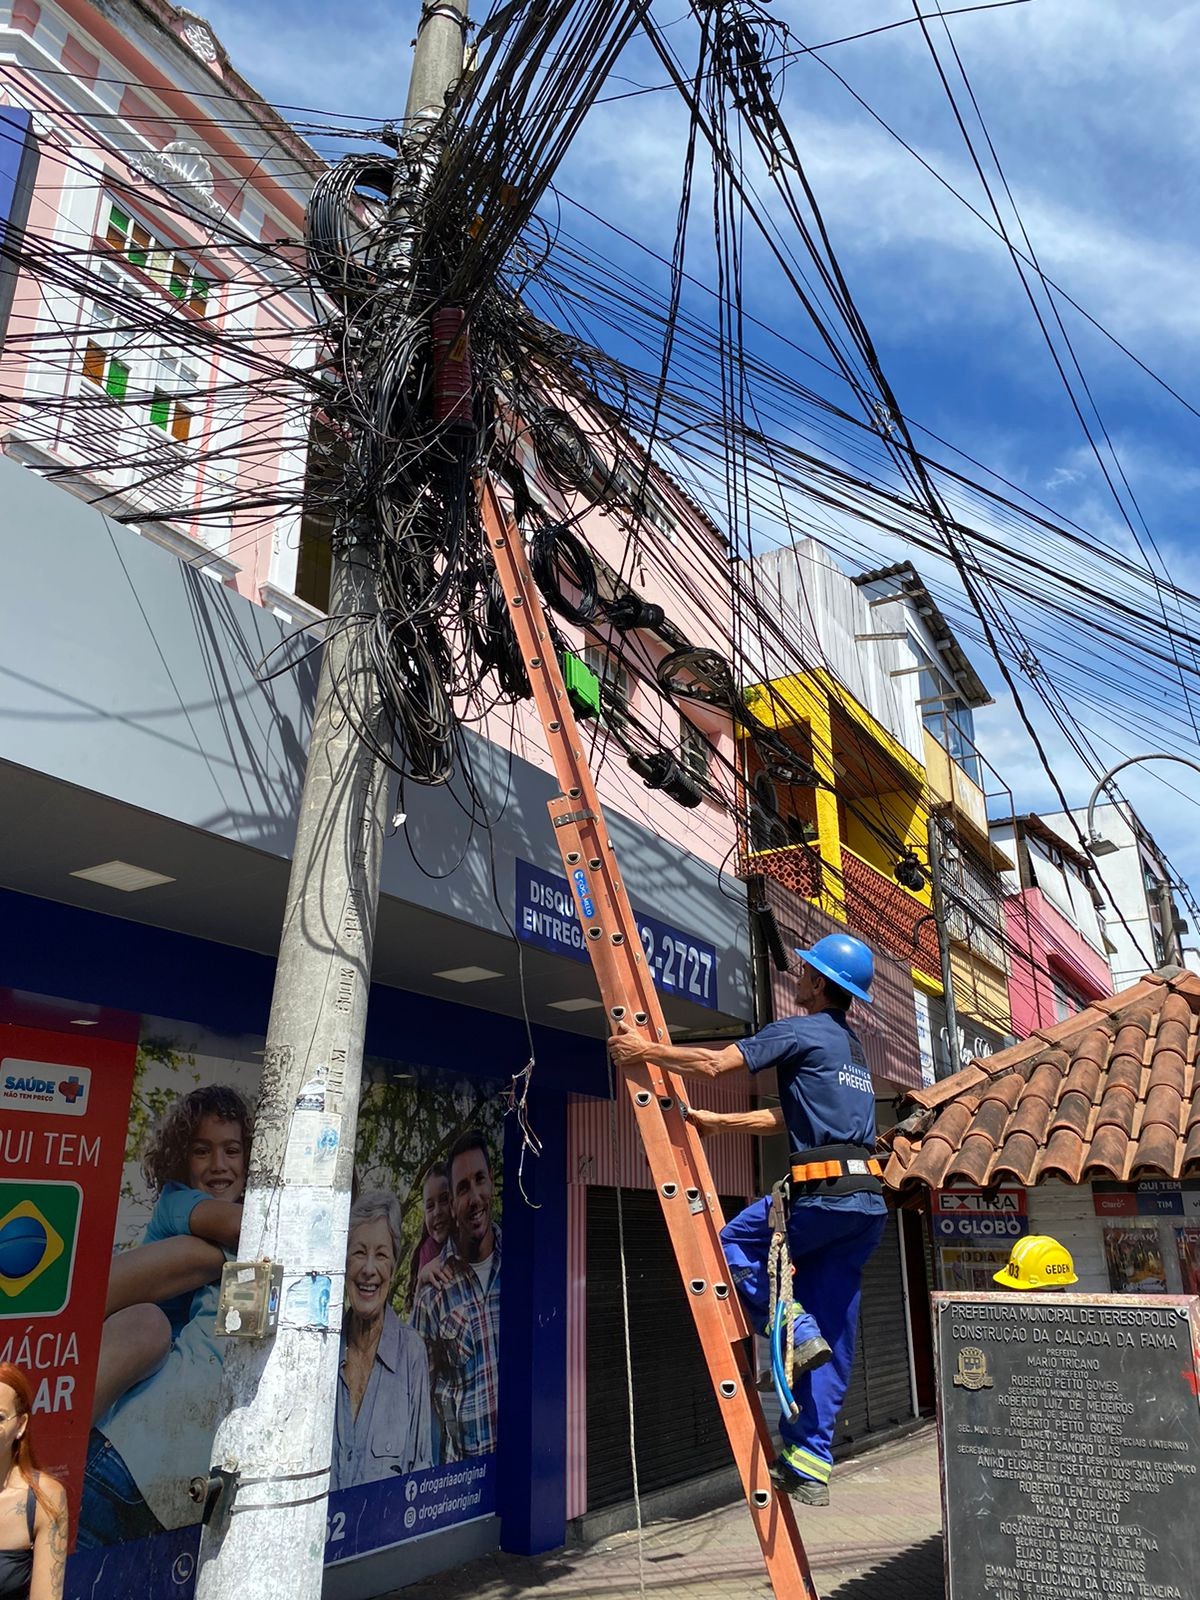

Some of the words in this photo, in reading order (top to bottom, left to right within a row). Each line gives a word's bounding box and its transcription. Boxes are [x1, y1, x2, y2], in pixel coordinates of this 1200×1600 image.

[636, 922, 712, 998] 2-2727
[4, 1076, 55, 1094] SAÚDE
[838, 1071, 875, 1095] PREFEIT
[0, 1129, 33, 1163] UI
[44, 1132, 101, 1167] TEM
[1138, 1182, 1158, 1191] QUI
[1161, 1182, 1181, 1190] TEM
[941, 1195, 1016, 1210] EXTRA
[1101, 1200, 1121, 1208] Claro
[941, 1219, 954, 1234] O
[958, 1221, 1021, 1235] GLOBO
[951, 1305, 1018, 1320] PREFEITURA
[1019, 1307, 1078, 1323] MUNICIPAL
[1080, 1309, 1096, 1324] DE
[1098, 1309, 1178, 1328] TERESÓPOLIS
[952, 1324, 1027, 1342] CONSTRUÇÃO
[1033, 1328, 1050, 1343] DA
[1055, 1329, 1111, 1347] CALÇADA
[1116, 1332, 1135, 1348] DA
[1140, 1333, 1177, 1350] FAMA
[1046, 1348, 1077, 1357] PREFEITO
[1027, 1356, 1057, 1368] MARIO
[1060, 1358, 1099, 1370] TRICANO
[1038, 1368, 1089, 1379] VICE-PREFEITO
[1011, 1375, 1051, 1388] ROBERTO
[1054, 1377, 1083, 1390] PETTO
[1086, 1379, 1119, 1392] GOMES
[998, 1395, 1038, 1408] ROBERTO
[1043, 1398, 1063, 1409] LUIZ
[1069, 1399, 1081, 1411] DE
[1087, 1400, 1134, 1414] MEDEIROS
[1050, 1389, 1085, 1400] MUNICIPAL
[1087, 1391, 1097, 1400] DE
[1100, 1392, 1124, 1402] OBRAS
[1009, 1416, 1050, 1430] ROBERTO
[1055, 1420, 1084, 1432] PETTO
[1090, 1422, 1123, 1436] GOMES
[1047, 1410, 1056, 1419] DE
[1086, 1413, 1126, 1424] (INTERINO)
[992, 1427, 1001, 1436] DE
[1062, 1432, 1067, 1441] E
[1070, 1433, 1106, 1444] PROJETOS
[1110, 1435, 1146, 1448] ESPECIAIS
[1021, 1438, 1051, 1451] DARCY
[1055, 1440, 1094, 1455] SANDRO
[1098, 1444, 1121, 1457] DIAS
[997, 1448, 1032, 1459] MUNICIPAL
[1035, 1451, 1044, 1460] DE
[1046, 1452, 1077, 1463] TURISMO
[1079, 1455, 1084, 1464] E
[1086, 1456, 1151, 1470] DESENVOLVIMENTO
[1153, 1461, 1197, 1474] ECONÔMICO
[977, 1456, 1004, 1469] ANIKO
[1111, 1467, 1131, 1480] DOS
[1135, 1469, 1174, 1485] SANTOS
[1036, 1473, 1072, 1485] MUNICIPAL
[1076, 1477, 1085, 1486] DE
[1019, 1481, 1060, 1495] ROBERTO
[1064, 1485, 1093, 1498] LENZI
[1097, 1488, 1130, 1503] GOMES
[1068, 1498, 1078, 1507] DE
[1017, 1515, 1069, 1528] PROCURADORA
[1073, 1521, 1097, 1532] GERAL
[1036, 1505, 1071, 1519] MAGDA
[1076, 1508, 1119, 1525] COPELLO
[1117, 1533, 1131, 1549] DE
[1016, 1546, 1042, 1560] ELIAS
[1046, 1550, 1059, 1562] DE
[1063, 1552, 1096, 1567] SOUZA
[1100, 1556, 1146, 1573] MARTINS
[1060, 1542, 1096, 1555] MUNICIPAL
[1100, 1546, 1109, 1556] DE
[1112, 1548, 1145, 1560] CULTURA
[985, 1564, 1037, 1583] EMMANUEL
[1041, 1571, 1081, 1588] LUCIANO
[1085, 1577, 1099, 1590] DA
[1102, 1580, 1135, 1594] COSTA
[1060, 1565, 1097, 1578] MUNICIPAL
[1100, 1569, 1110, 1579] DE
[1113, 1571, 1146, 1583] FAZENDA
[1023, 1583, 1032, 1593] DE
